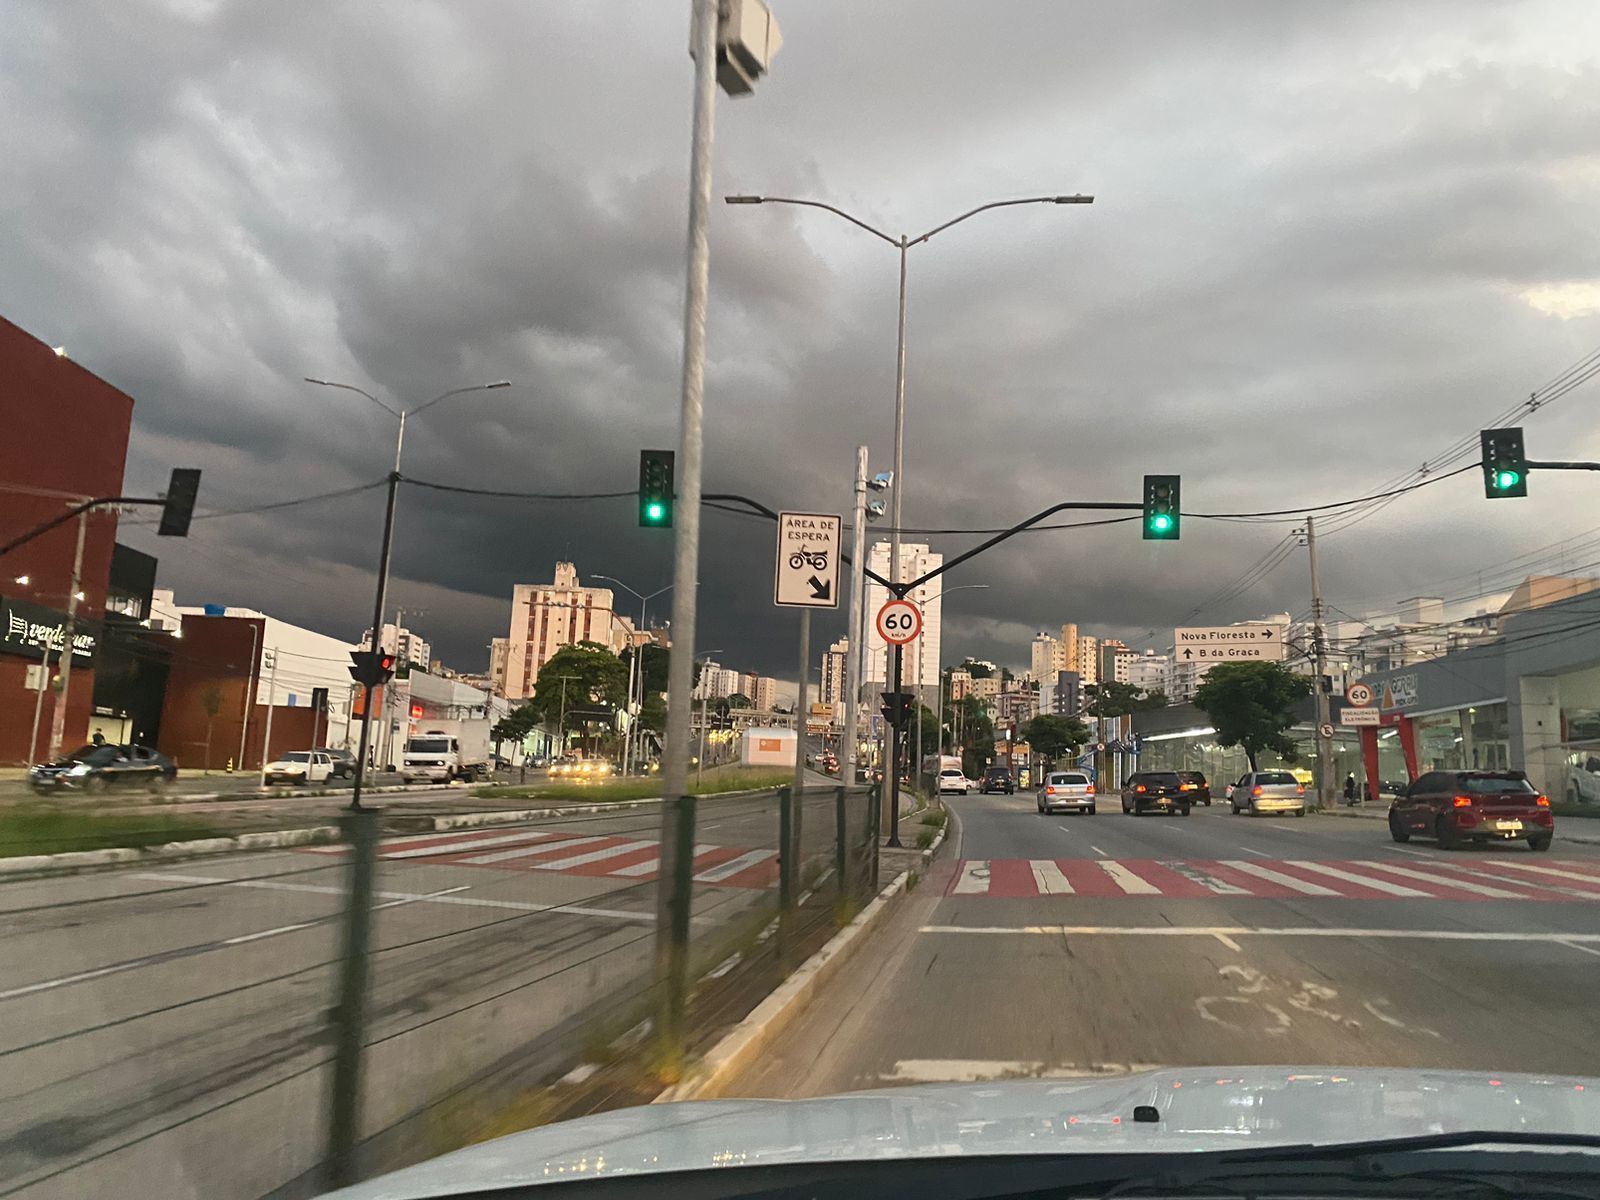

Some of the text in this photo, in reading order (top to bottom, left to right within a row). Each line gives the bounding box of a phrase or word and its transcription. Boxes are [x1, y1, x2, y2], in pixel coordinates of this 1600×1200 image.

[820, 521, 834, 530] DE
[787, 531, 831, 542] ESPERA
[885, 613, 912, 630] 60
[1181, 631, 1256, 641] Nova Floresta
[1211, 648, 1225, 657] da
[1351, 690, 1368, 700] 60
